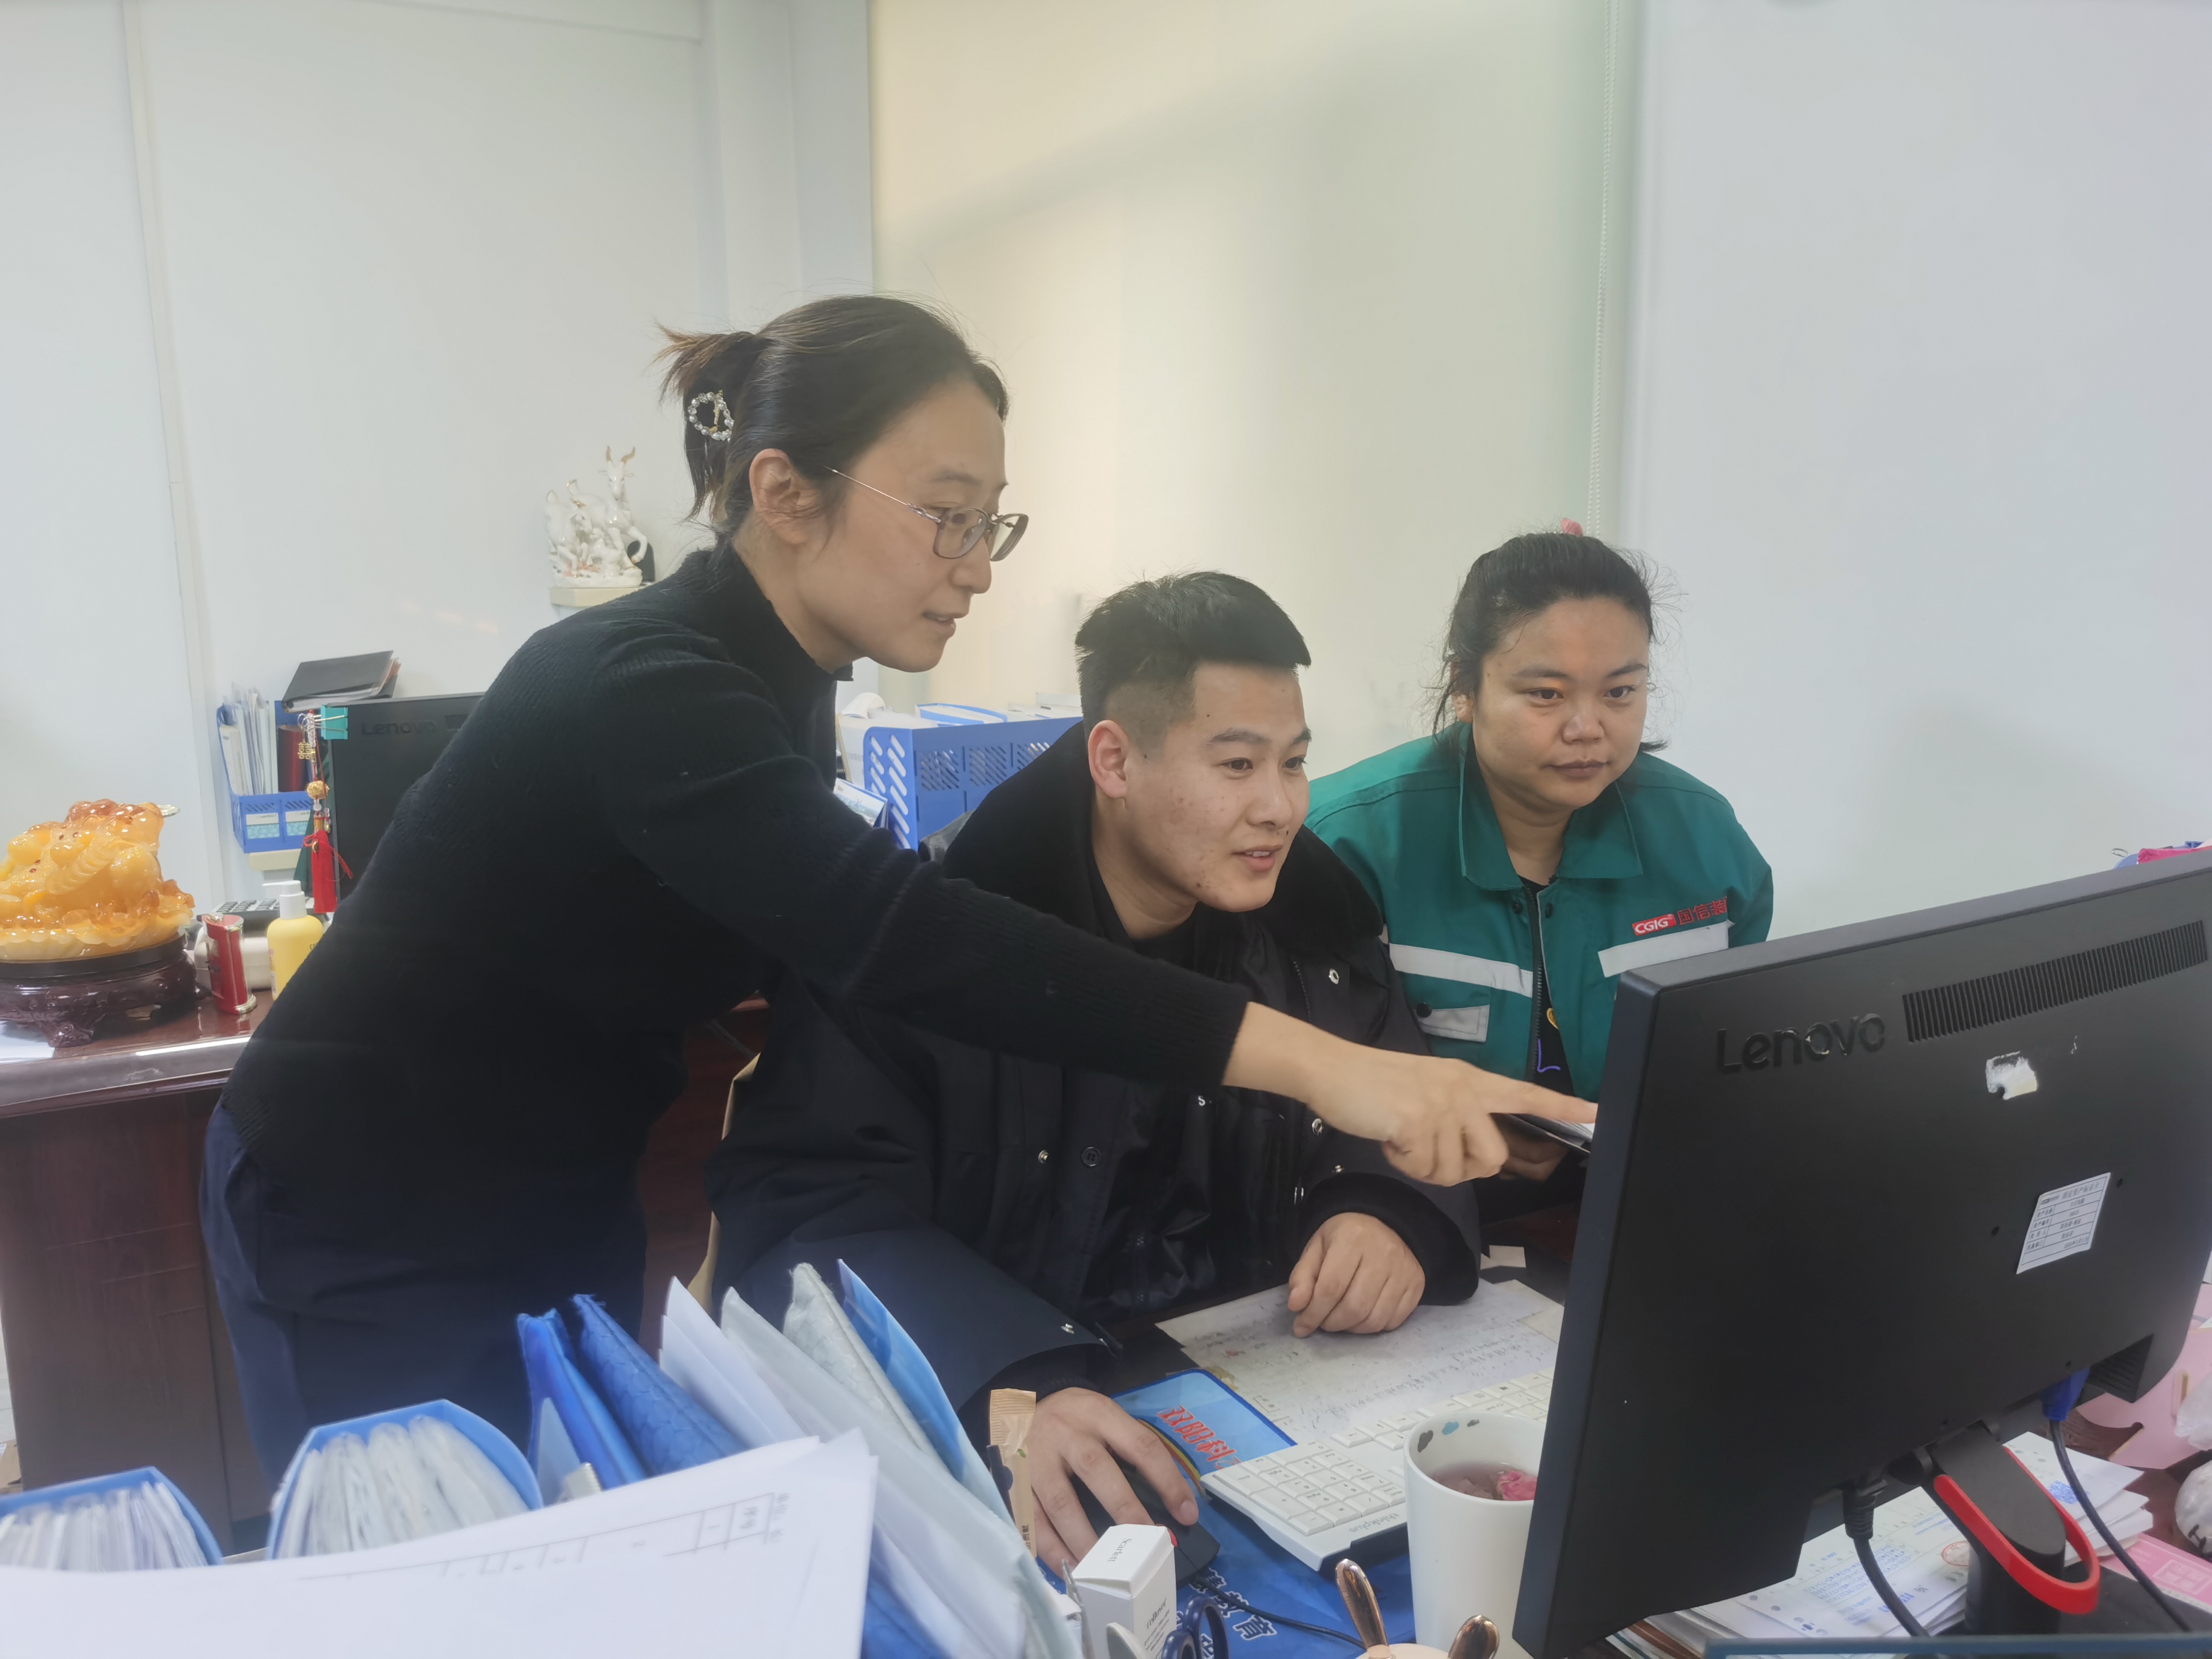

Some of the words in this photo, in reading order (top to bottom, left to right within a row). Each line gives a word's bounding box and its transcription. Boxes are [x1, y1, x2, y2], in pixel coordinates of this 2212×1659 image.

[361, 720, 437, 735] Lenovo
[1677, 896, 1727, 926] 国信装
[1634, 916, 1671, 934] CGIG
[1717, 1013, 1885, 1073] Lenovo
[1349, 1513, 1399, 1532] thinkplus
